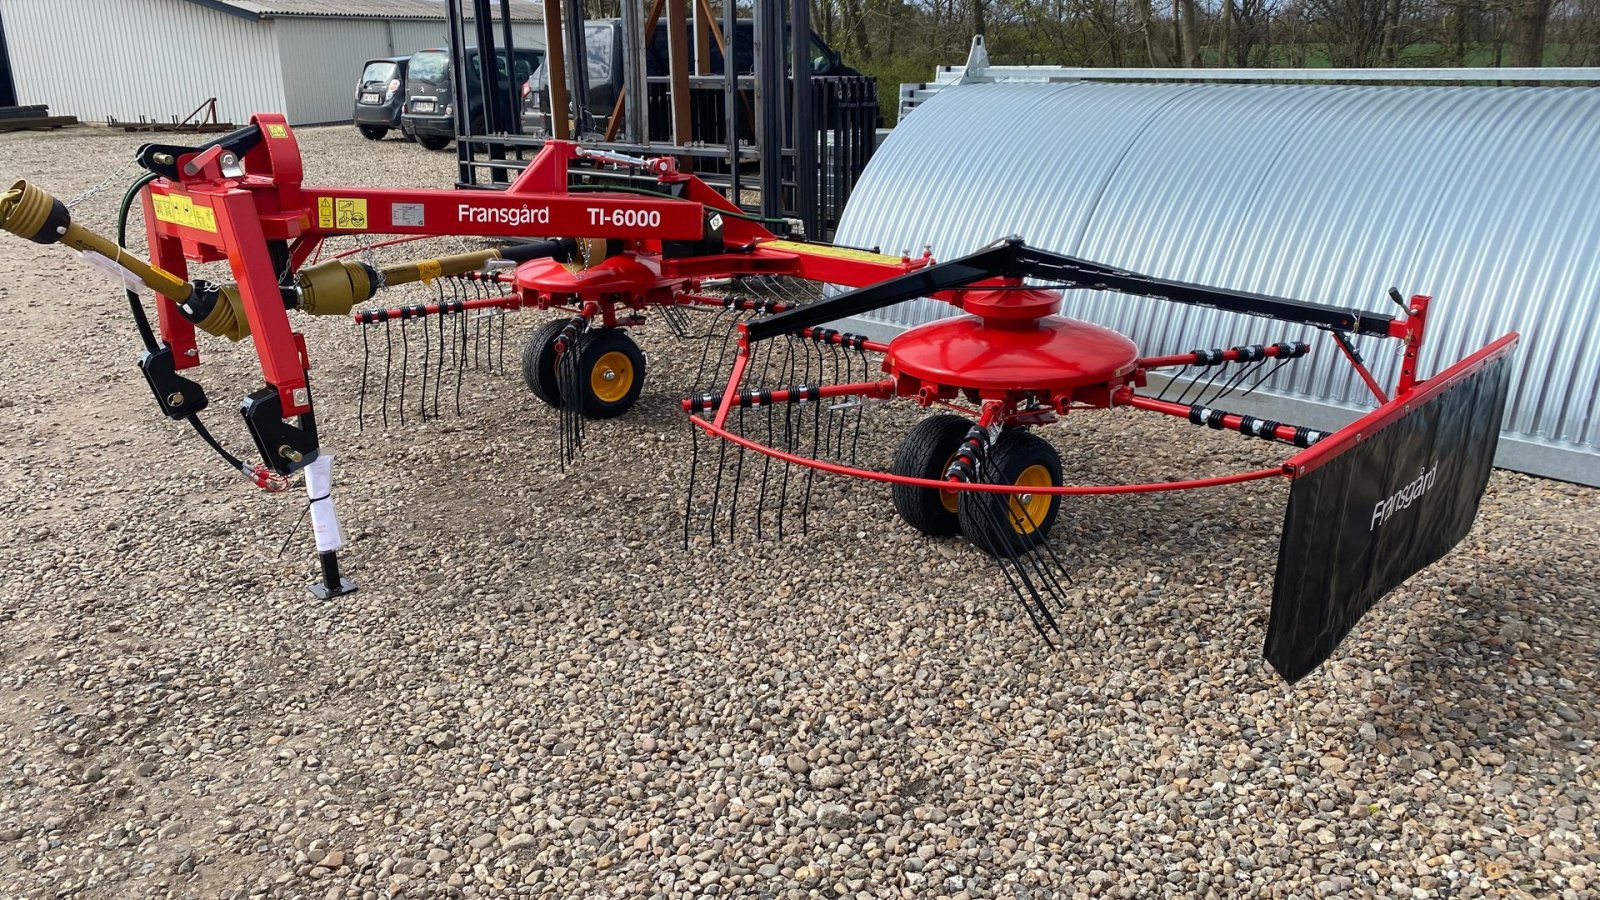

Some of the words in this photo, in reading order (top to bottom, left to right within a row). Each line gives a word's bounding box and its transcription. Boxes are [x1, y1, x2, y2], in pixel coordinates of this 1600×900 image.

[458, 204, 550, 226] Fransgård
[587, 207, 661, 227] TI-6000
[1369, 459, 1439, 531] Fransgård
